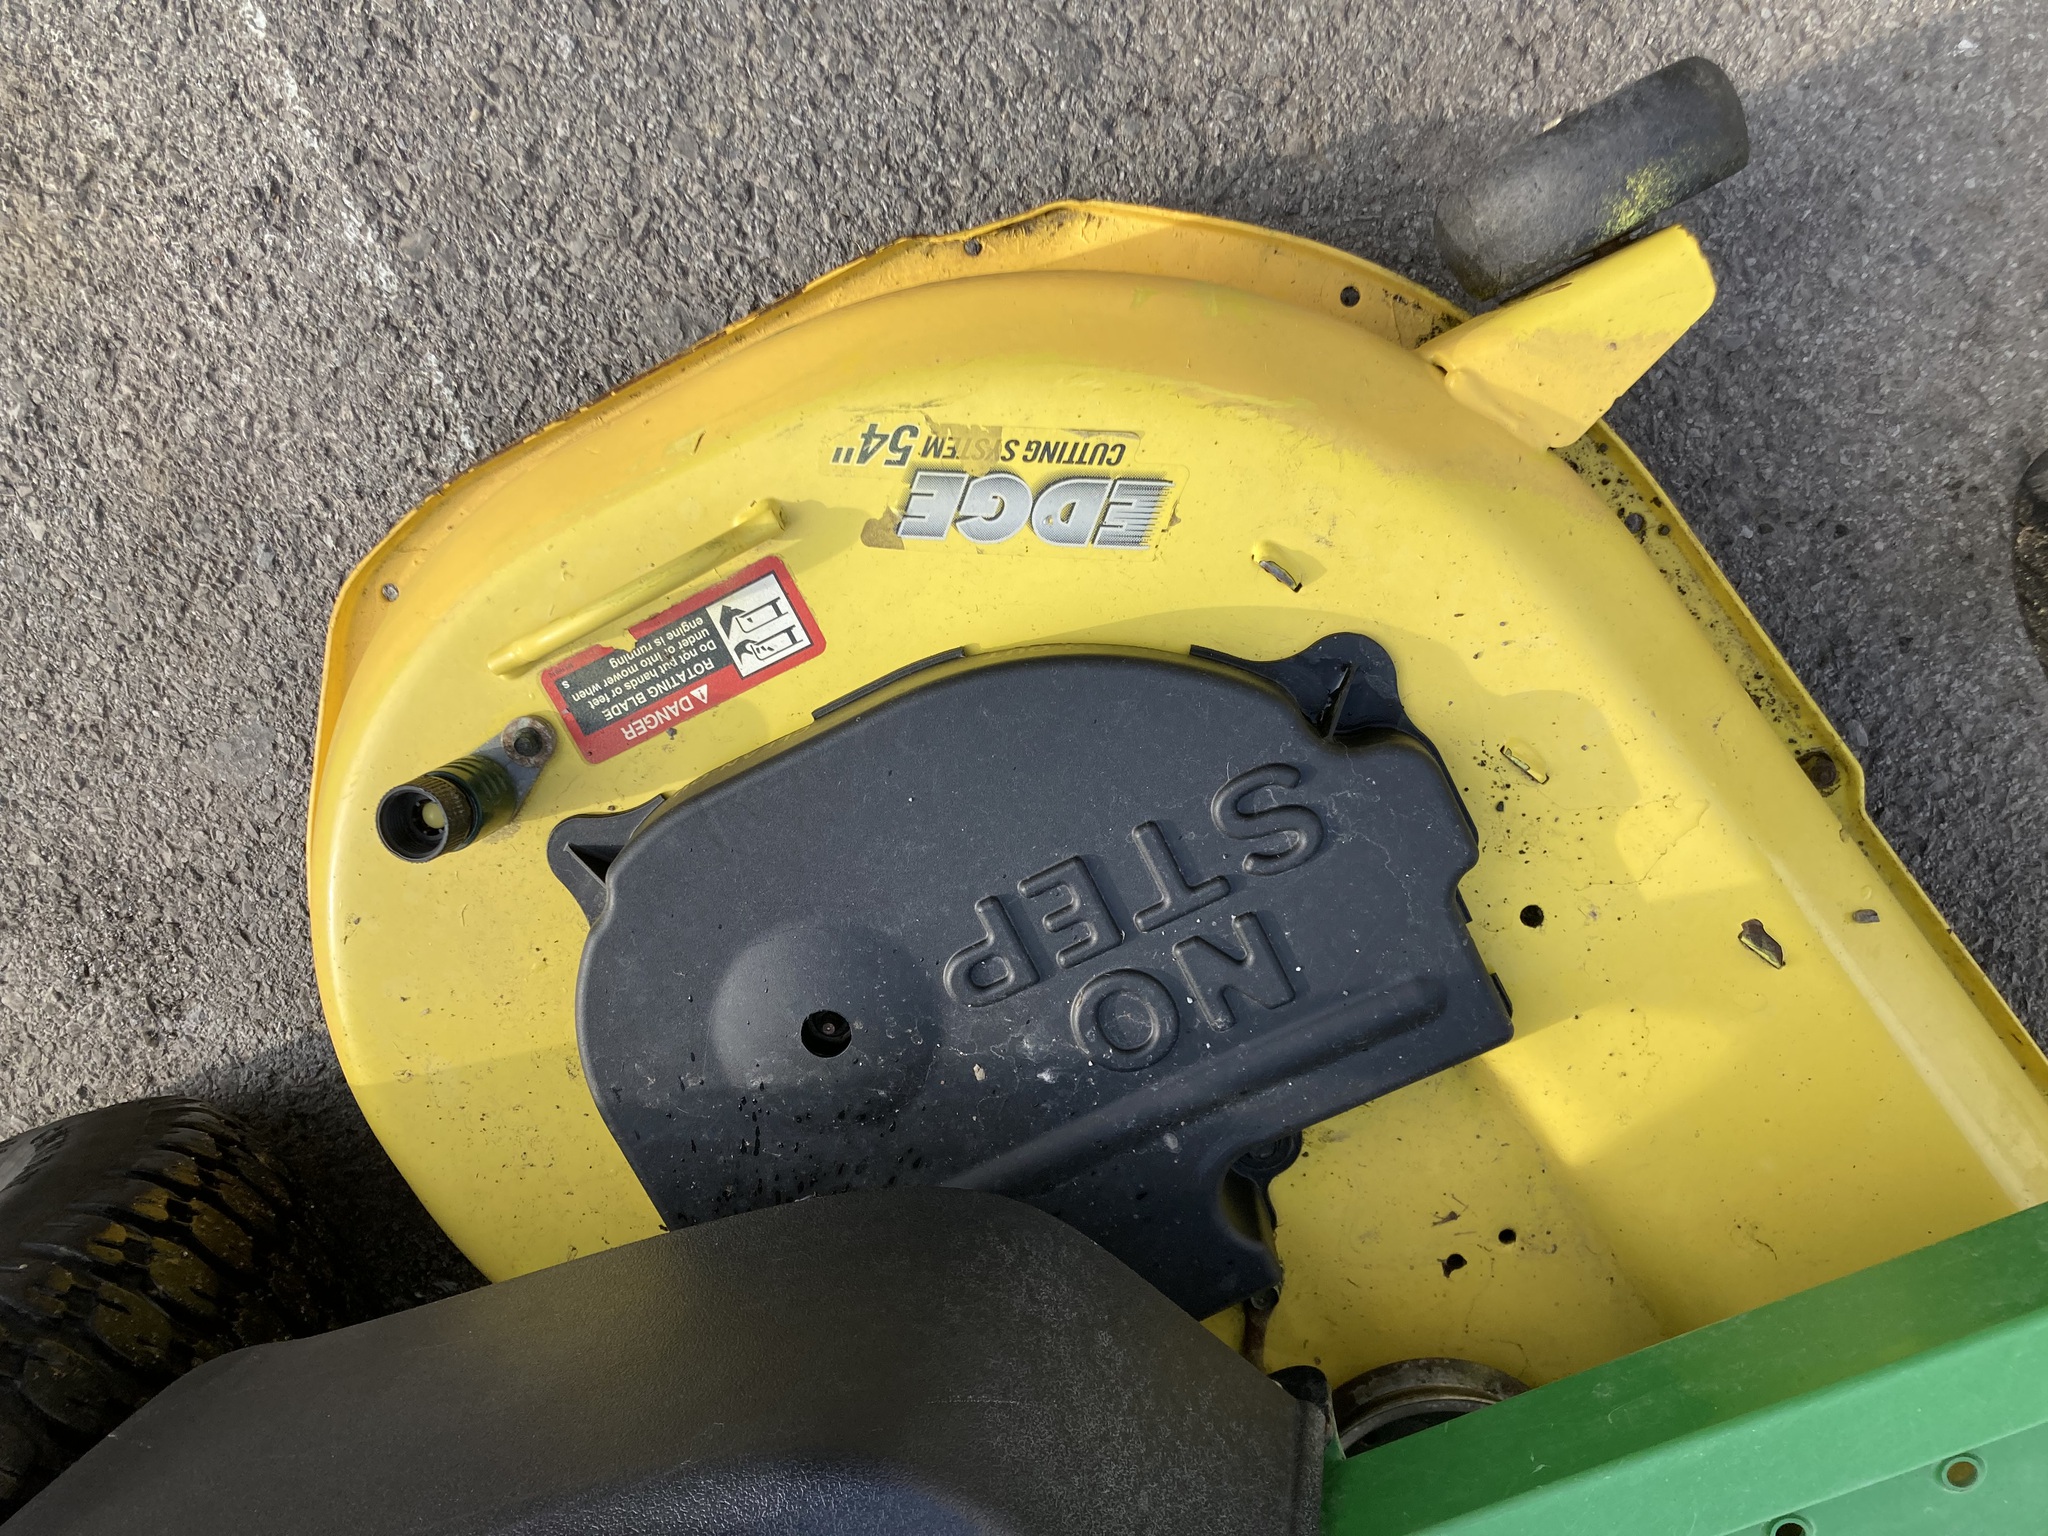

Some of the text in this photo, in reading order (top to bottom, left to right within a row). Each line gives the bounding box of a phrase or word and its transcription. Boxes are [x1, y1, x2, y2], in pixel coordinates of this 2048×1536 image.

[1022, 441, 1127, 467] CUTTING
[896, 470, 1175, 550] EDGE
[608, 617, 704, 669] engine is running
[640, 651, 664, 666] into
[677, 628, 710, 650] under
[571, 682, 602, 702] when
[588, 639, 717, 710] Do not put hands or feet
[601, 657, 715, 721] ROTATING BLADE
[603, 663, 640, 688] mower
[620, 695, 694, 741] DANGER
[942, 761, 1325, 1008] STEP
[1070, 910, 1296, 1073] NO
